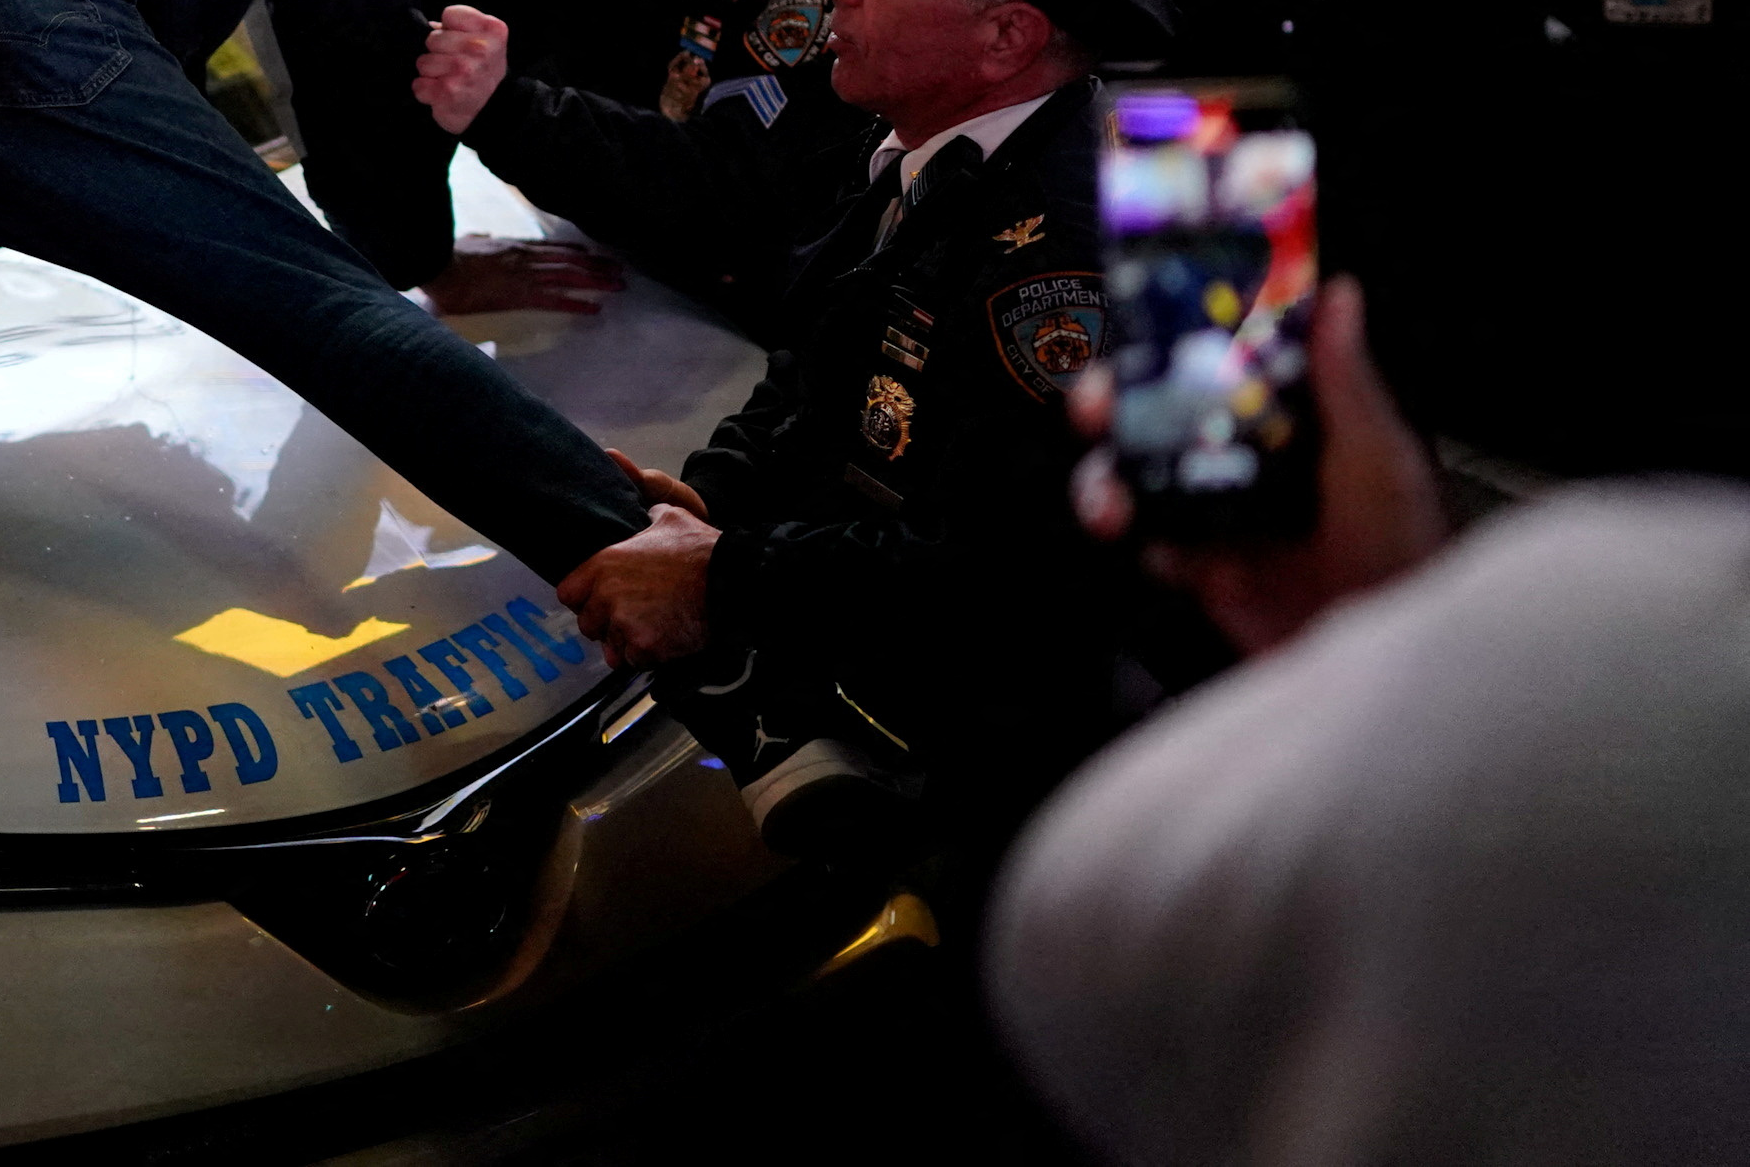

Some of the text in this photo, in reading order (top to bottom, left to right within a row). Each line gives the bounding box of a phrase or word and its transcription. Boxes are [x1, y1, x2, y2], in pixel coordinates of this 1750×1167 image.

[1001, 290, 1111, 329] DEPARTMENT
[1018, 278, 1083, 304] POLICE
[1006, 344, 1055, 395] CITY OF
[46, 595, 586, 804] NYPD TRAFFIC
